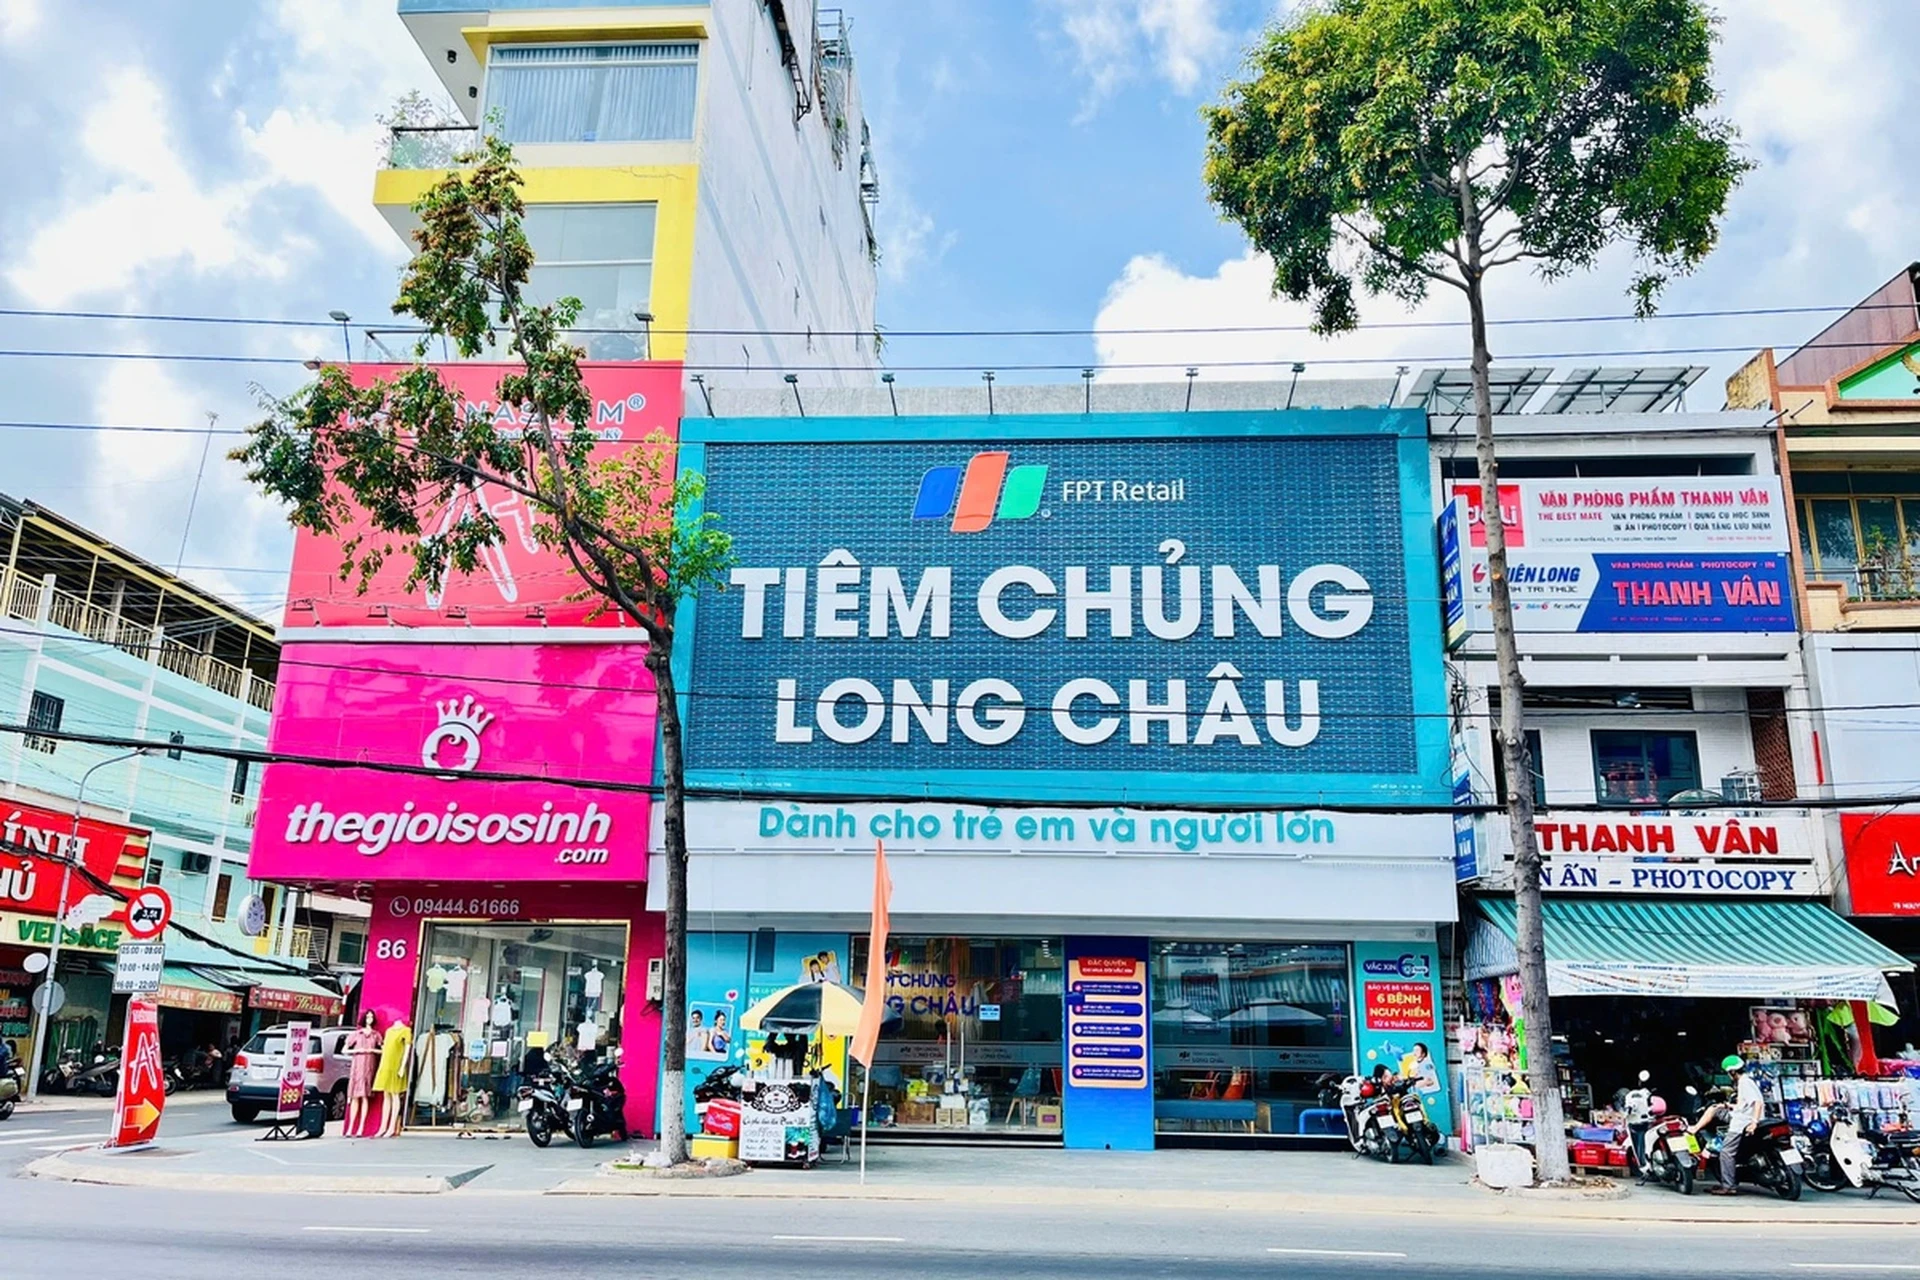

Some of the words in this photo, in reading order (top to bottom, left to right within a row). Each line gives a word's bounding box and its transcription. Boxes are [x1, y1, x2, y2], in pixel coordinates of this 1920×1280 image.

[1062, 480, 1106, 501] FPT
[1112, 478, 1185, 501] Retail
[1539, 490, 1569, 507] VĂN
[1573, 489, 1624, 507] PHÒNG
[1681, 491, 1734, 507] THANH
[1739, 488, 1769, 506] VÂN
[1538, 512, 1554, 521] THE
[1556, 512, 1577, 521] BEST
[1580, 512, 1603, 521] MATE
[1641, 523, 1687, 531] PHOTOCOPY
[1701, 561, 1757, 569] PHOTOCOPY
[1764, 561, 1775, 569] IN
[1538, 567, 1581, 583] LONG
[730, 548, 951, 639] TIÊM
[976, 538, 1374, 640] CHỦNG
[1612, 581, 1713, 606] THANH
[1721, 574, 1781, 606] VÂN
[775, 677, 1026, 745] LONG
[1051, 662, 1321, 748] CHÂU
[285, 801, 610, 855] thegioisosinh
[759, 804, 856, 839] Dành
[869, 809, 941, 840] cho
[1014, 816, 1075, 841] em
[1088, 808, 1135, 842] và
[1533, 824, 1675, 854] THANH
[1694, 819, 1779, 855] VÂN
[554, 845, 608, 864] .com
[1561, 863, 1598, 888] ẤN
[1631, 868, 1797, 891] PHOTOCOPY
[413, 898, 520, 915] 09444.61666
[376, 939, 407, 960] 86
[1383, 963, 1396, 971] XIN
[899, 969, 957, 988] CHỦNG
[910, 990, 977, 1016] CHÂU
[1376, 993, 1385, 1004] 6
[1387, 991, 1422, 1005] BỆNH
[1370, 1007, 1400, 1017] NGUY
